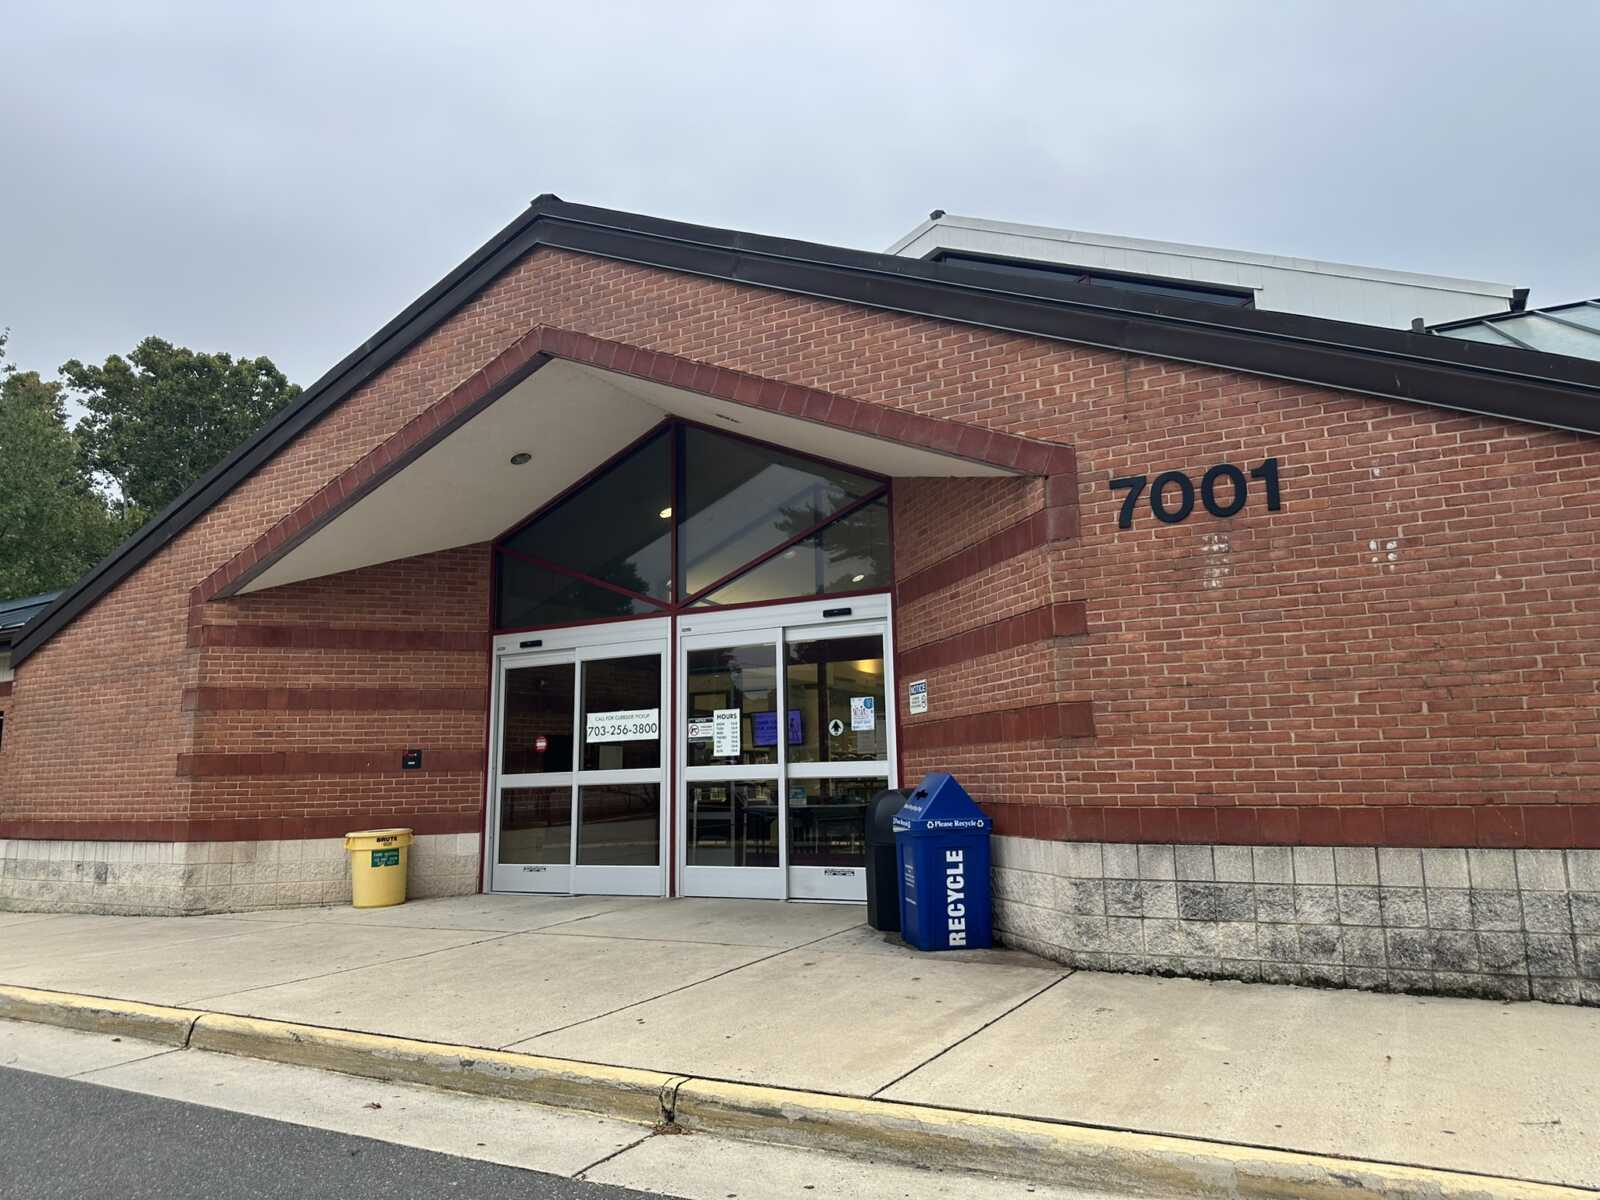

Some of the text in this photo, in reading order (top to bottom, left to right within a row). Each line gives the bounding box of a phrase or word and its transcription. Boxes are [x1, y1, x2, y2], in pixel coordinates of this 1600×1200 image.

[1109, 458, 1281, 529] 7001
[588, 722, 657, 737] 703-256-3800
[935, 819, 977, 829] Please Recycle
[946, 850, 967, 946] RECYCLE
